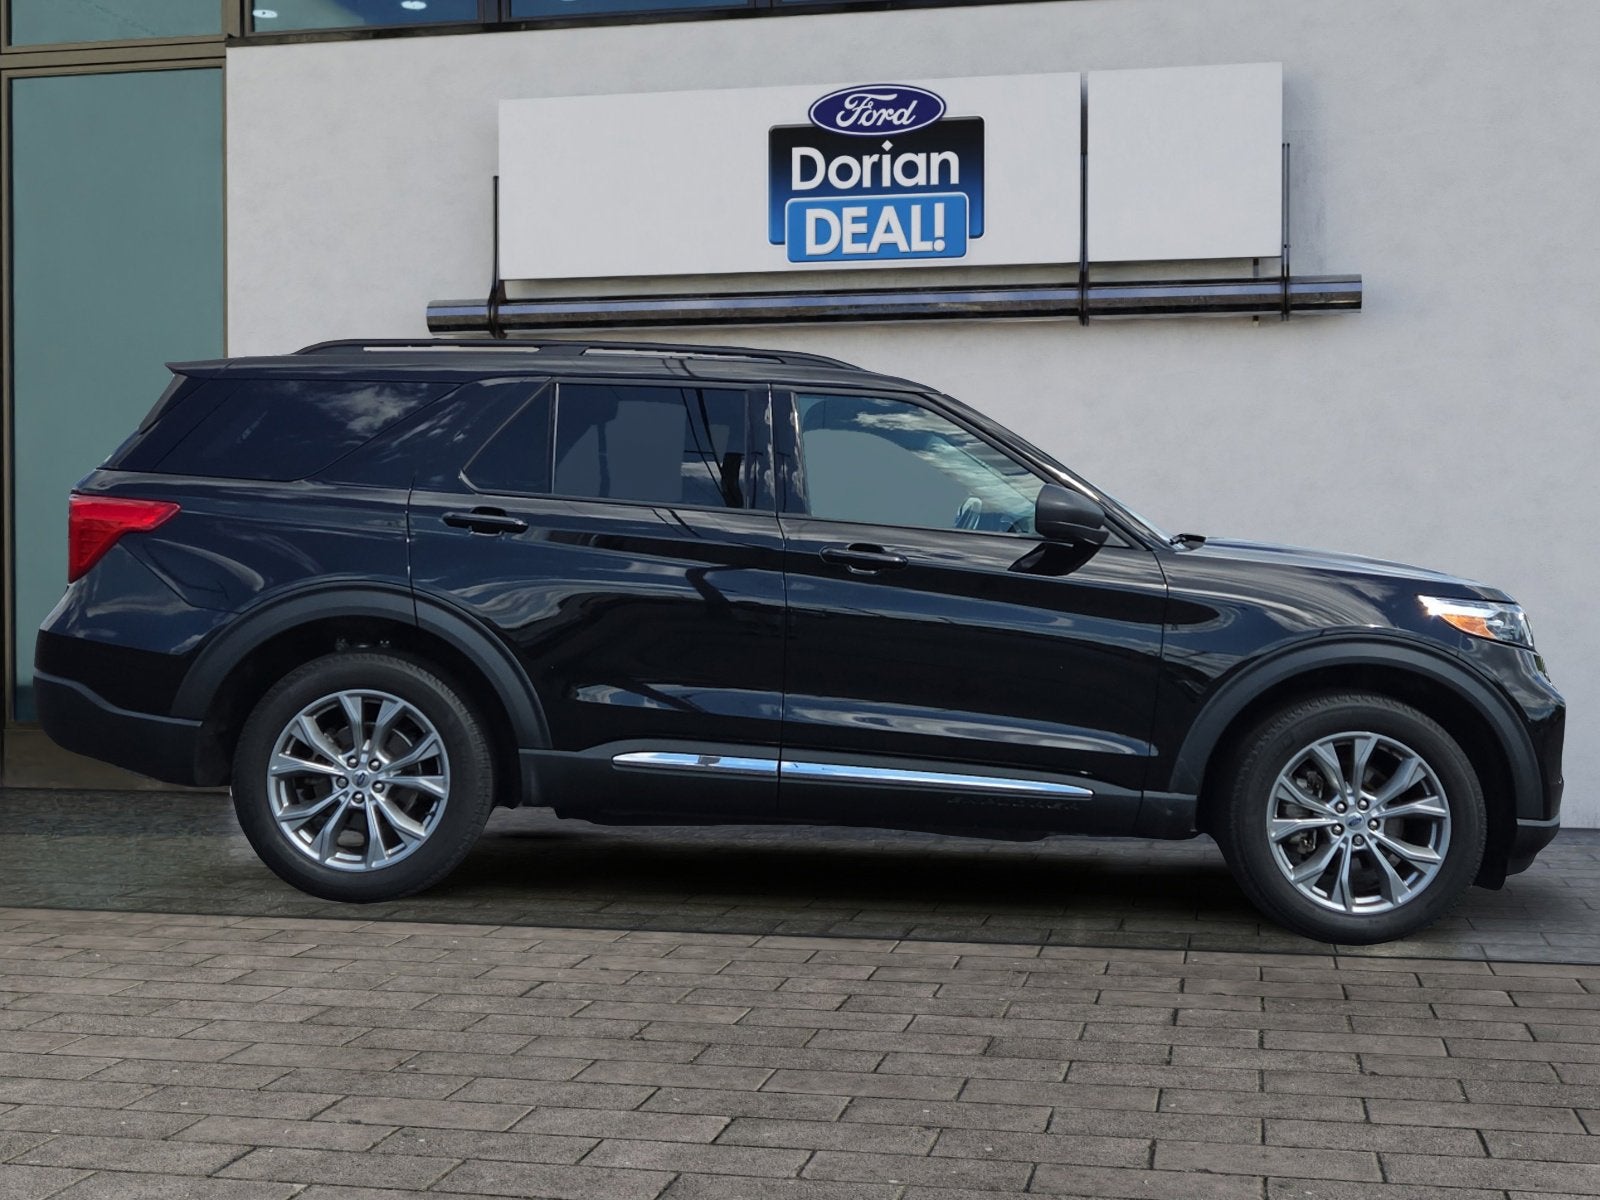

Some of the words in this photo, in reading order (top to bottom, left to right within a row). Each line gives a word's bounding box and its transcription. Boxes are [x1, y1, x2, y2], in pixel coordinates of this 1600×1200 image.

[835, 93, 918, 127] Ford
[791, 140, 960, 190] Dorian
[806, 202, 945, 256] DEAL!
